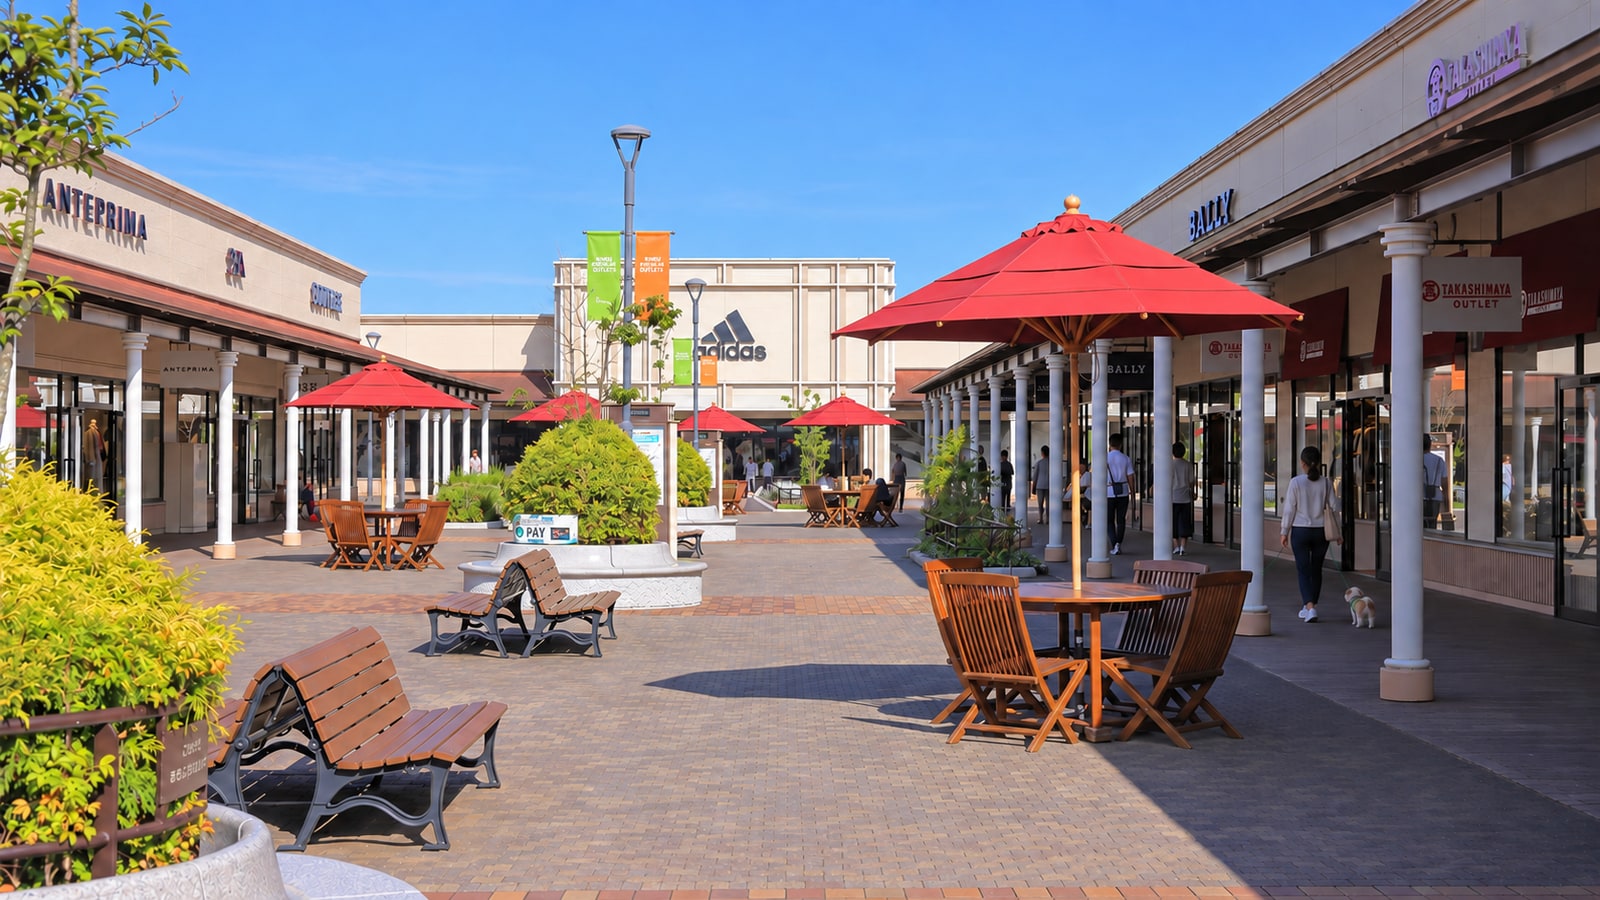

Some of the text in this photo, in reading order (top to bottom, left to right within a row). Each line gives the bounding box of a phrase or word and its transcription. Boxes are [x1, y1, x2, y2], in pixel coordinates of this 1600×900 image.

[43, 178, 147, 240] ANTEPRIMA
[1189, 188, 1234, 242] BALLY
[1442, 283, 1511, 295] TAKASHIMAYA
[1453, 300, 1499, 308] OUTLET
[1107, 364, 1146, 374] BALLY
[526, 527, 546, 538] PAY
